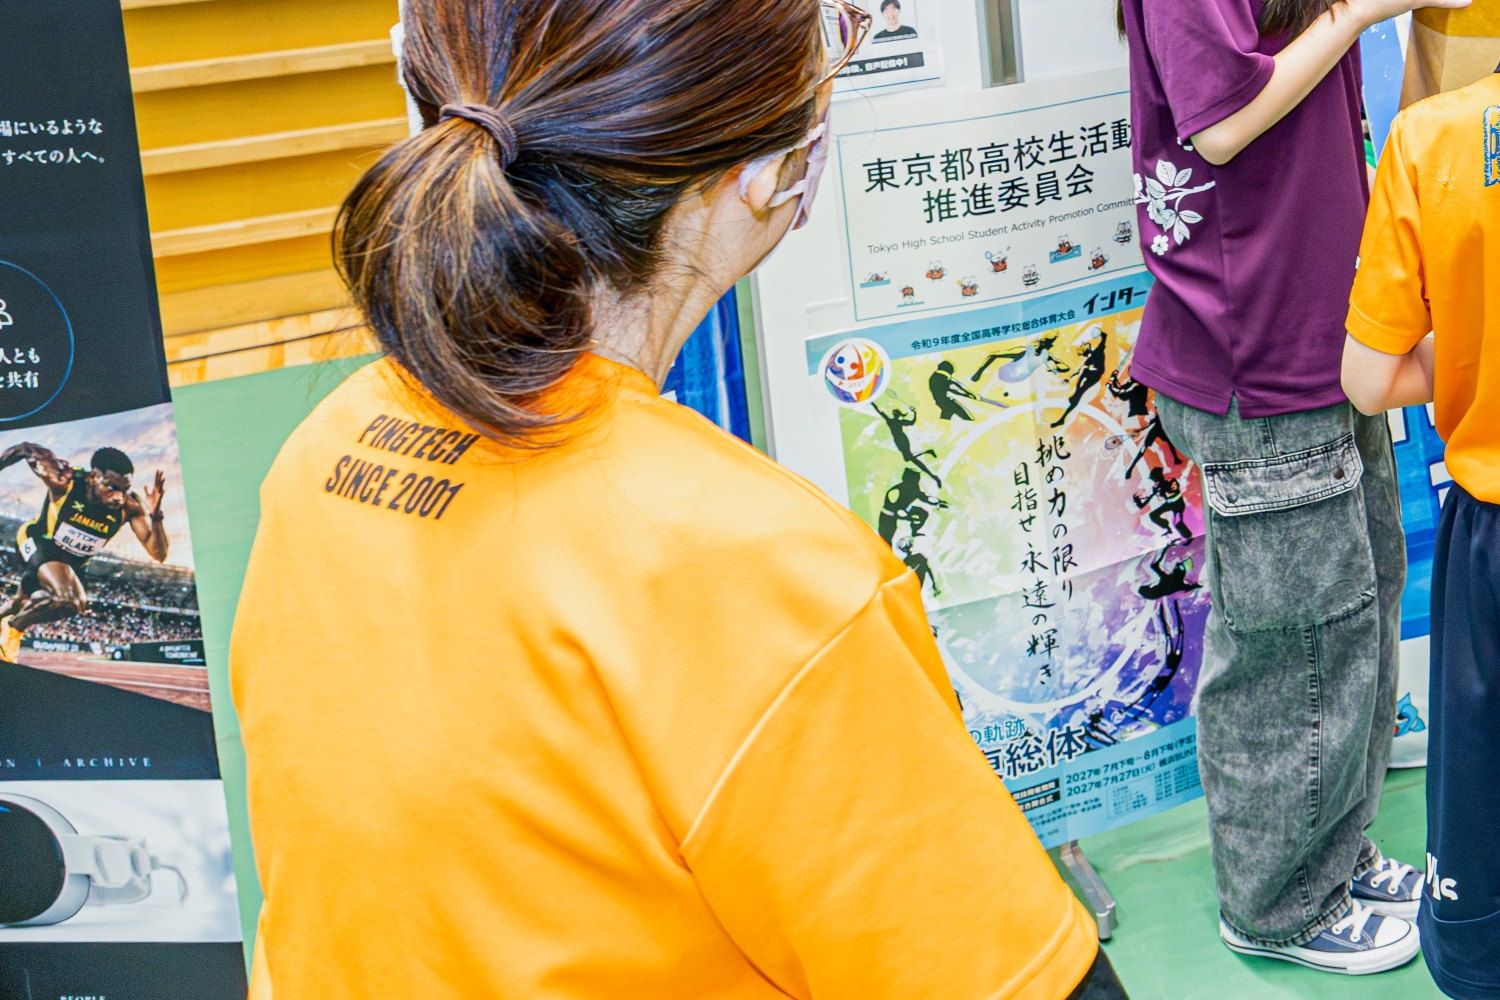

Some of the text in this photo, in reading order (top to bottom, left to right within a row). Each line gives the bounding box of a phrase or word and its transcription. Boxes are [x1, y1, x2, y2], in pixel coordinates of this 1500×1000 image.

[923, 163, 1095, 224] 推進委員会
[868, 242, 899, 256] Tokyo
[902, 236, 926, 251] High
[930, 230, 964, 245] School
[968, 224, 1008, 240] Student
[1011, 217, 1046, 235] Activity
[1049, 206, 1094, 224] Promotion
[911, 309, 1075, 350] 令和9年度全国高等学校総合体育大会
[357, 413, 481, 465] PINGTECH
[325, 454, 465, 520] SINCE 2001
[69, 512, 109, 534] JAMAICA
